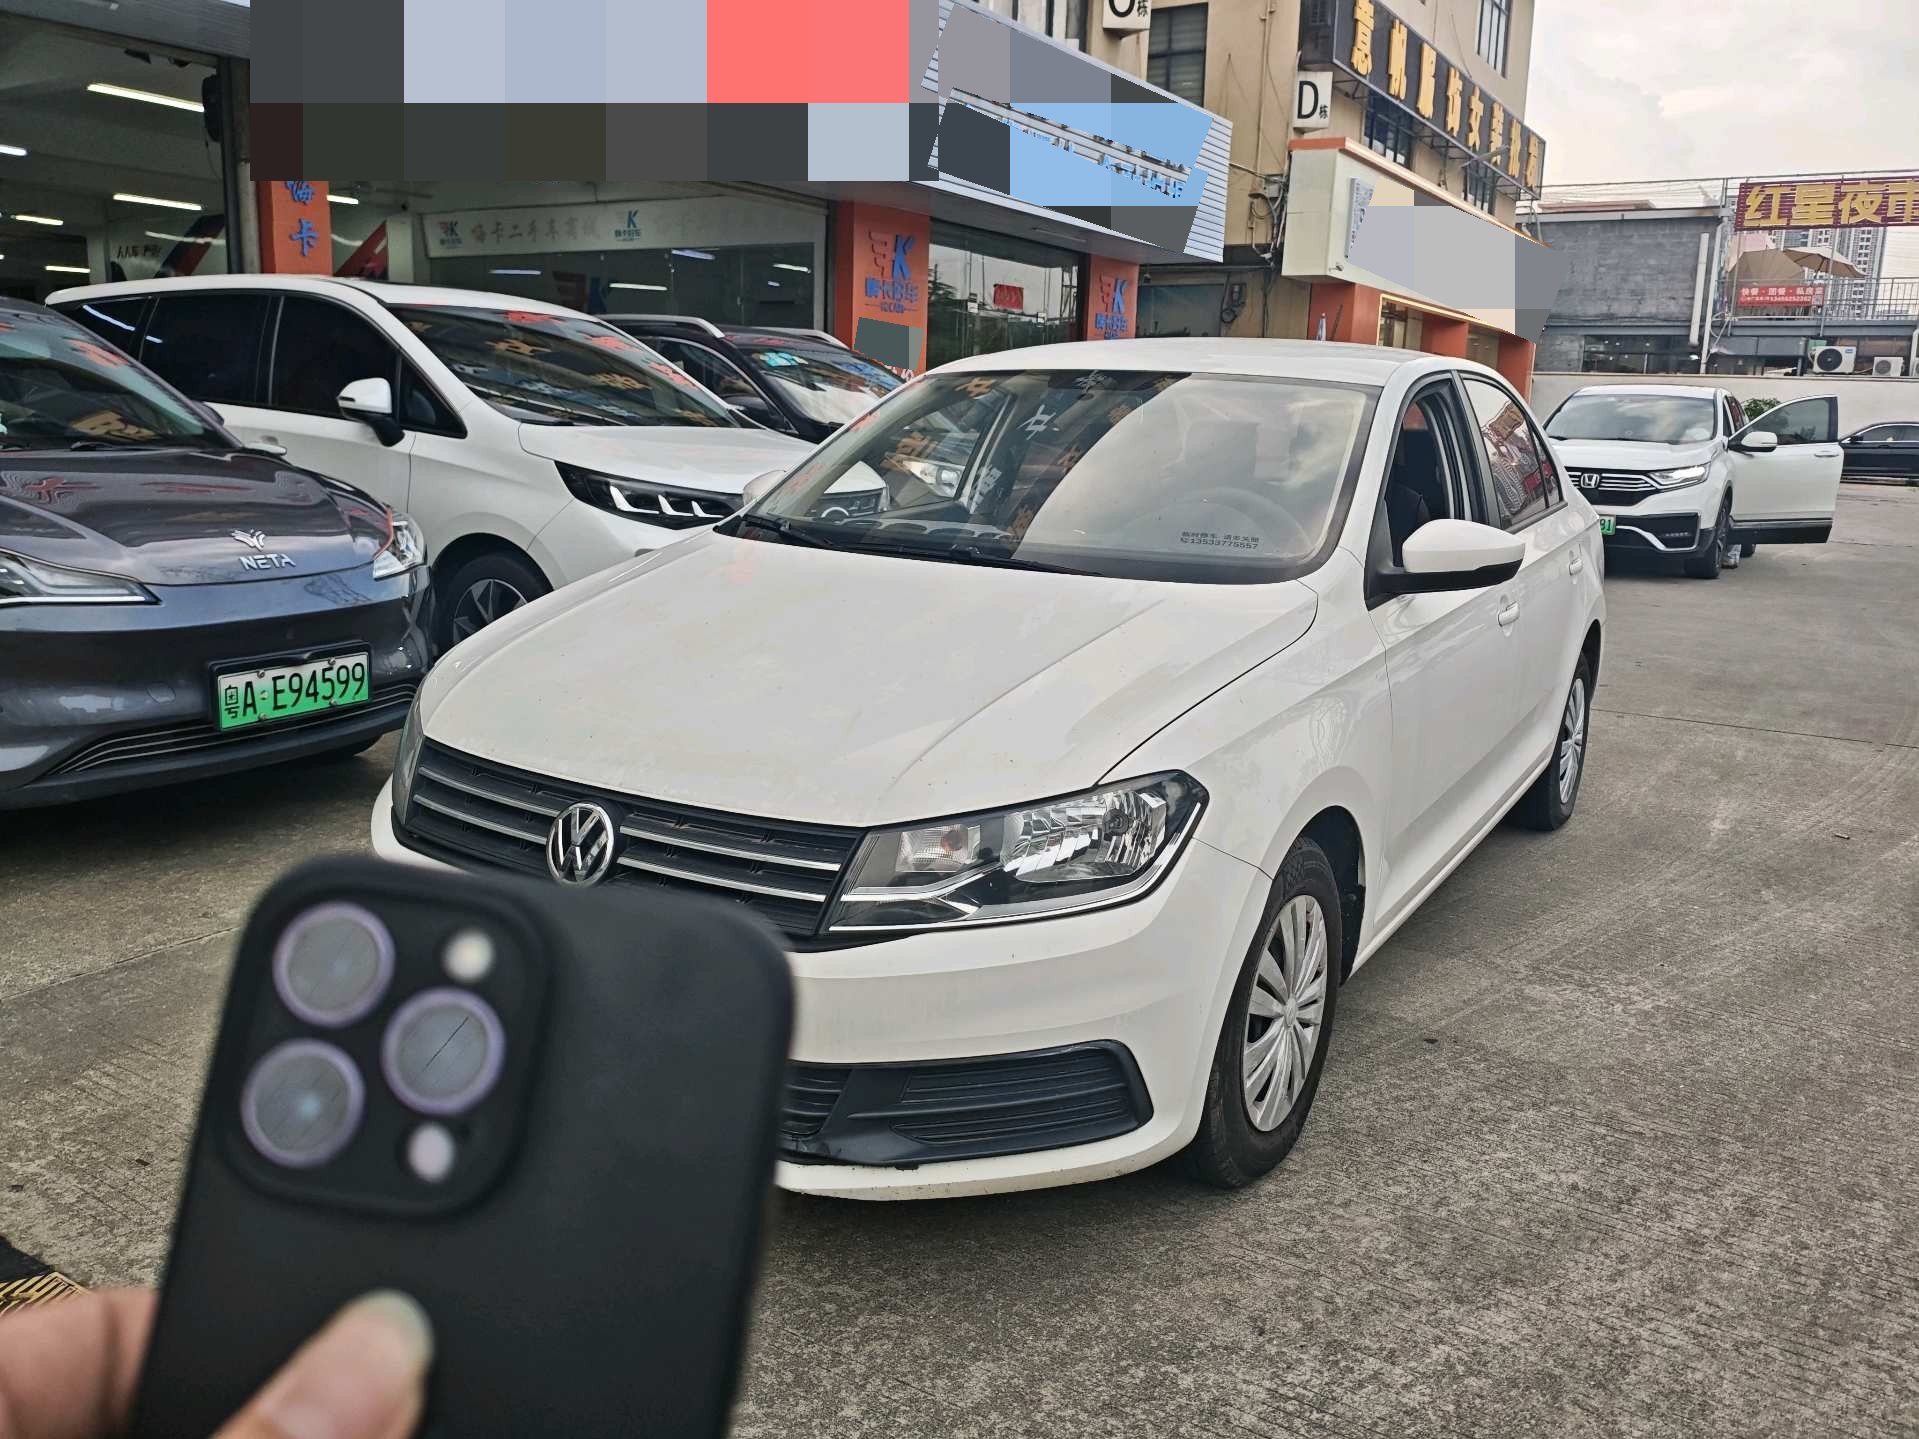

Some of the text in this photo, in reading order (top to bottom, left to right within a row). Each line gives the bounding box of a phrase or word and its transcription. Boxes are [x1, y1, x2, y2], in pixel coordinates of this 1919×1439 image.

[1743, 180, 1919, 227] 红星夜市
[239, 554, 297, 571] NETA
